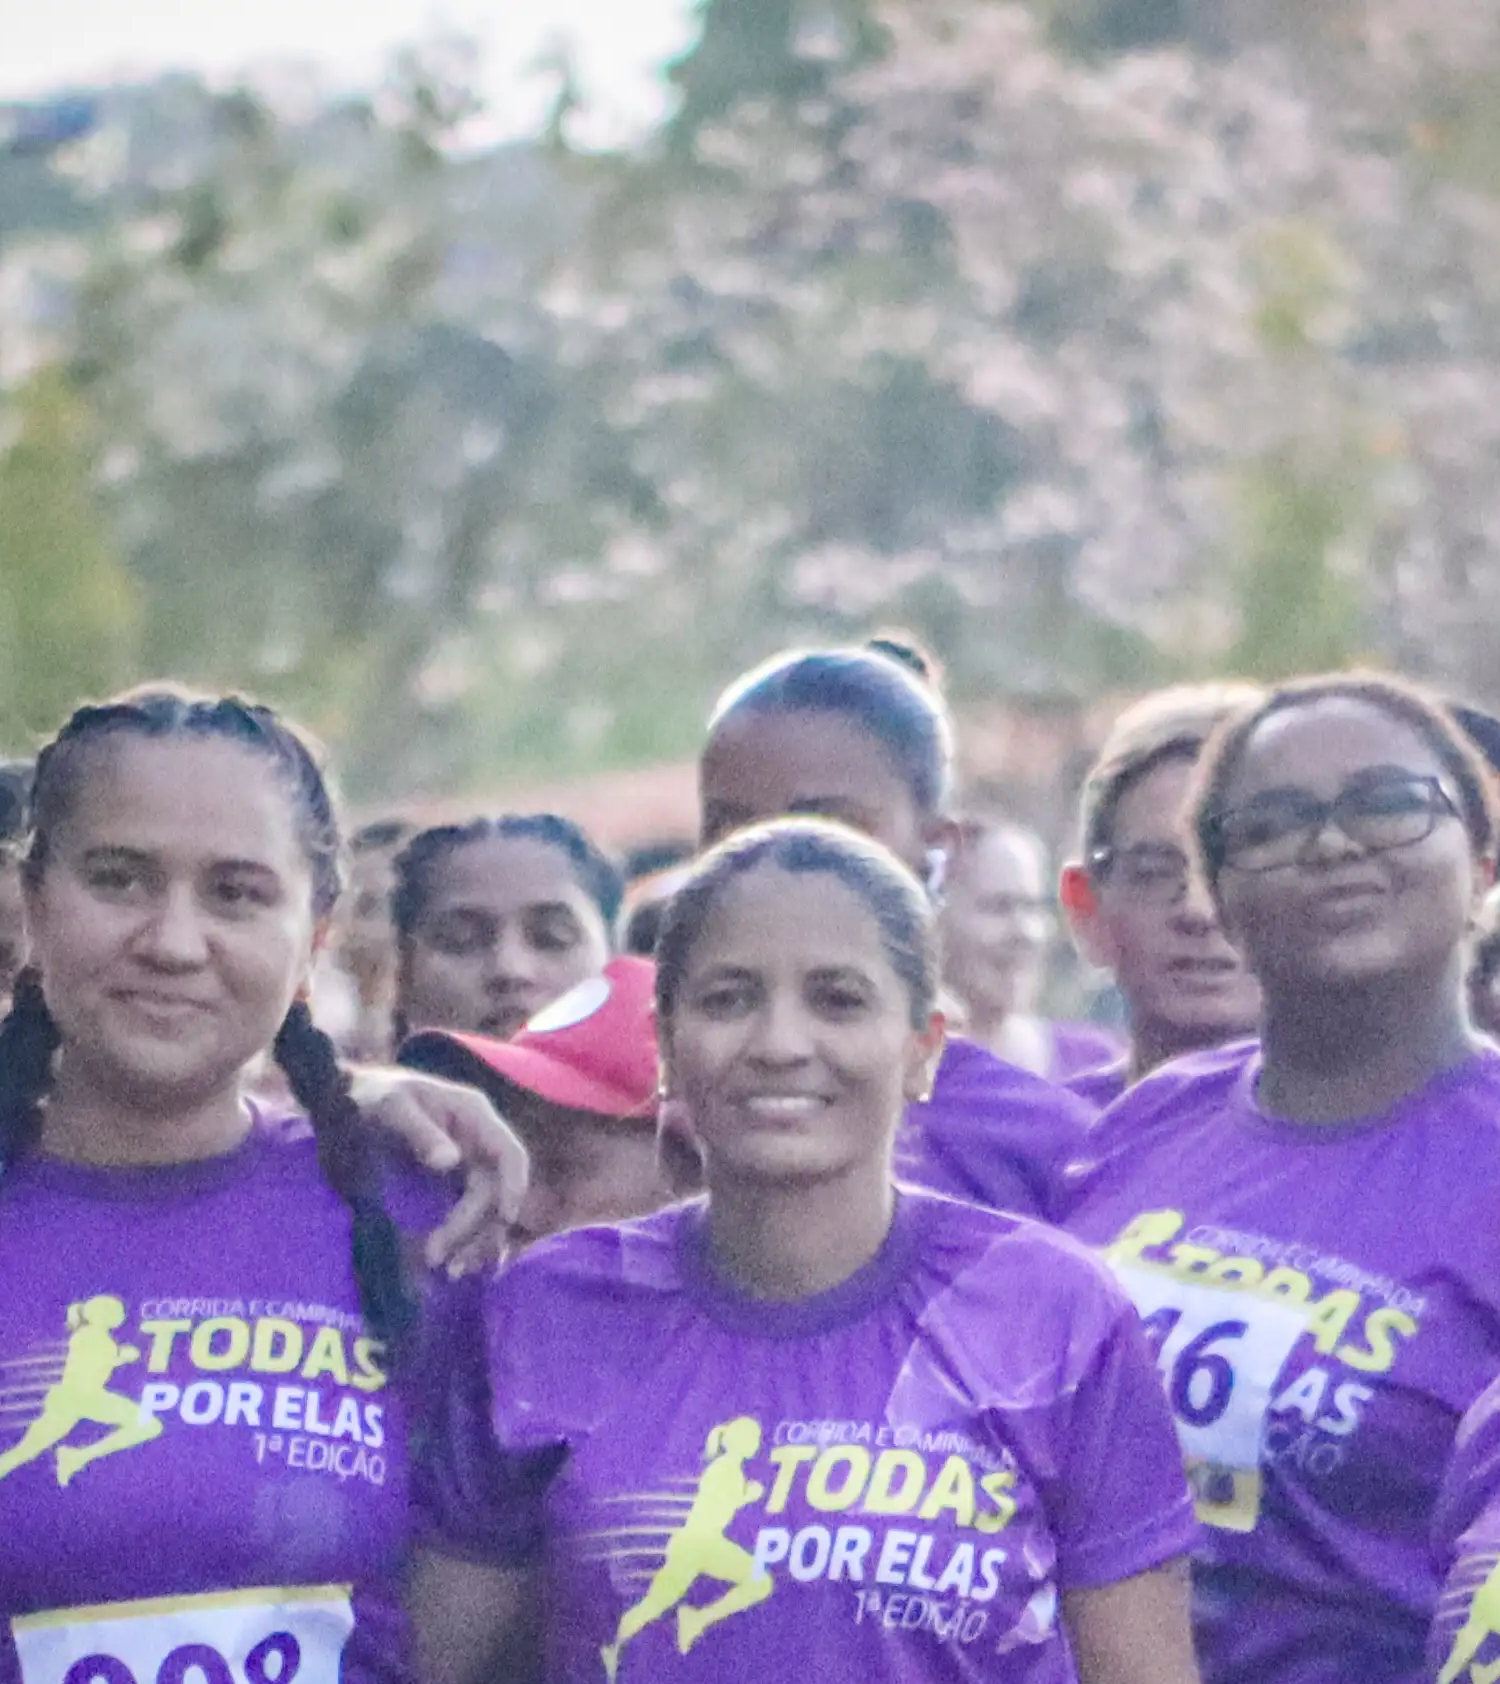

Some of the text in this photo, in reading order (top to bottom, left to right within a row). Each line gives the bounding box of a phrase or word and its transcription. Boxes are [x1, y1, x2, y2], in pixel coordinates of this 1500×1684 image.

[139, 1317, 388, 1393] TODAS
[138, 1382, 385, 1449] POR ELAS
[287, 1437, 386, 1486] EDIÇÃO
[764, 1444, 1017, 1534] TODAS
[750, 1523, 1008, 1601] POR ELAS
